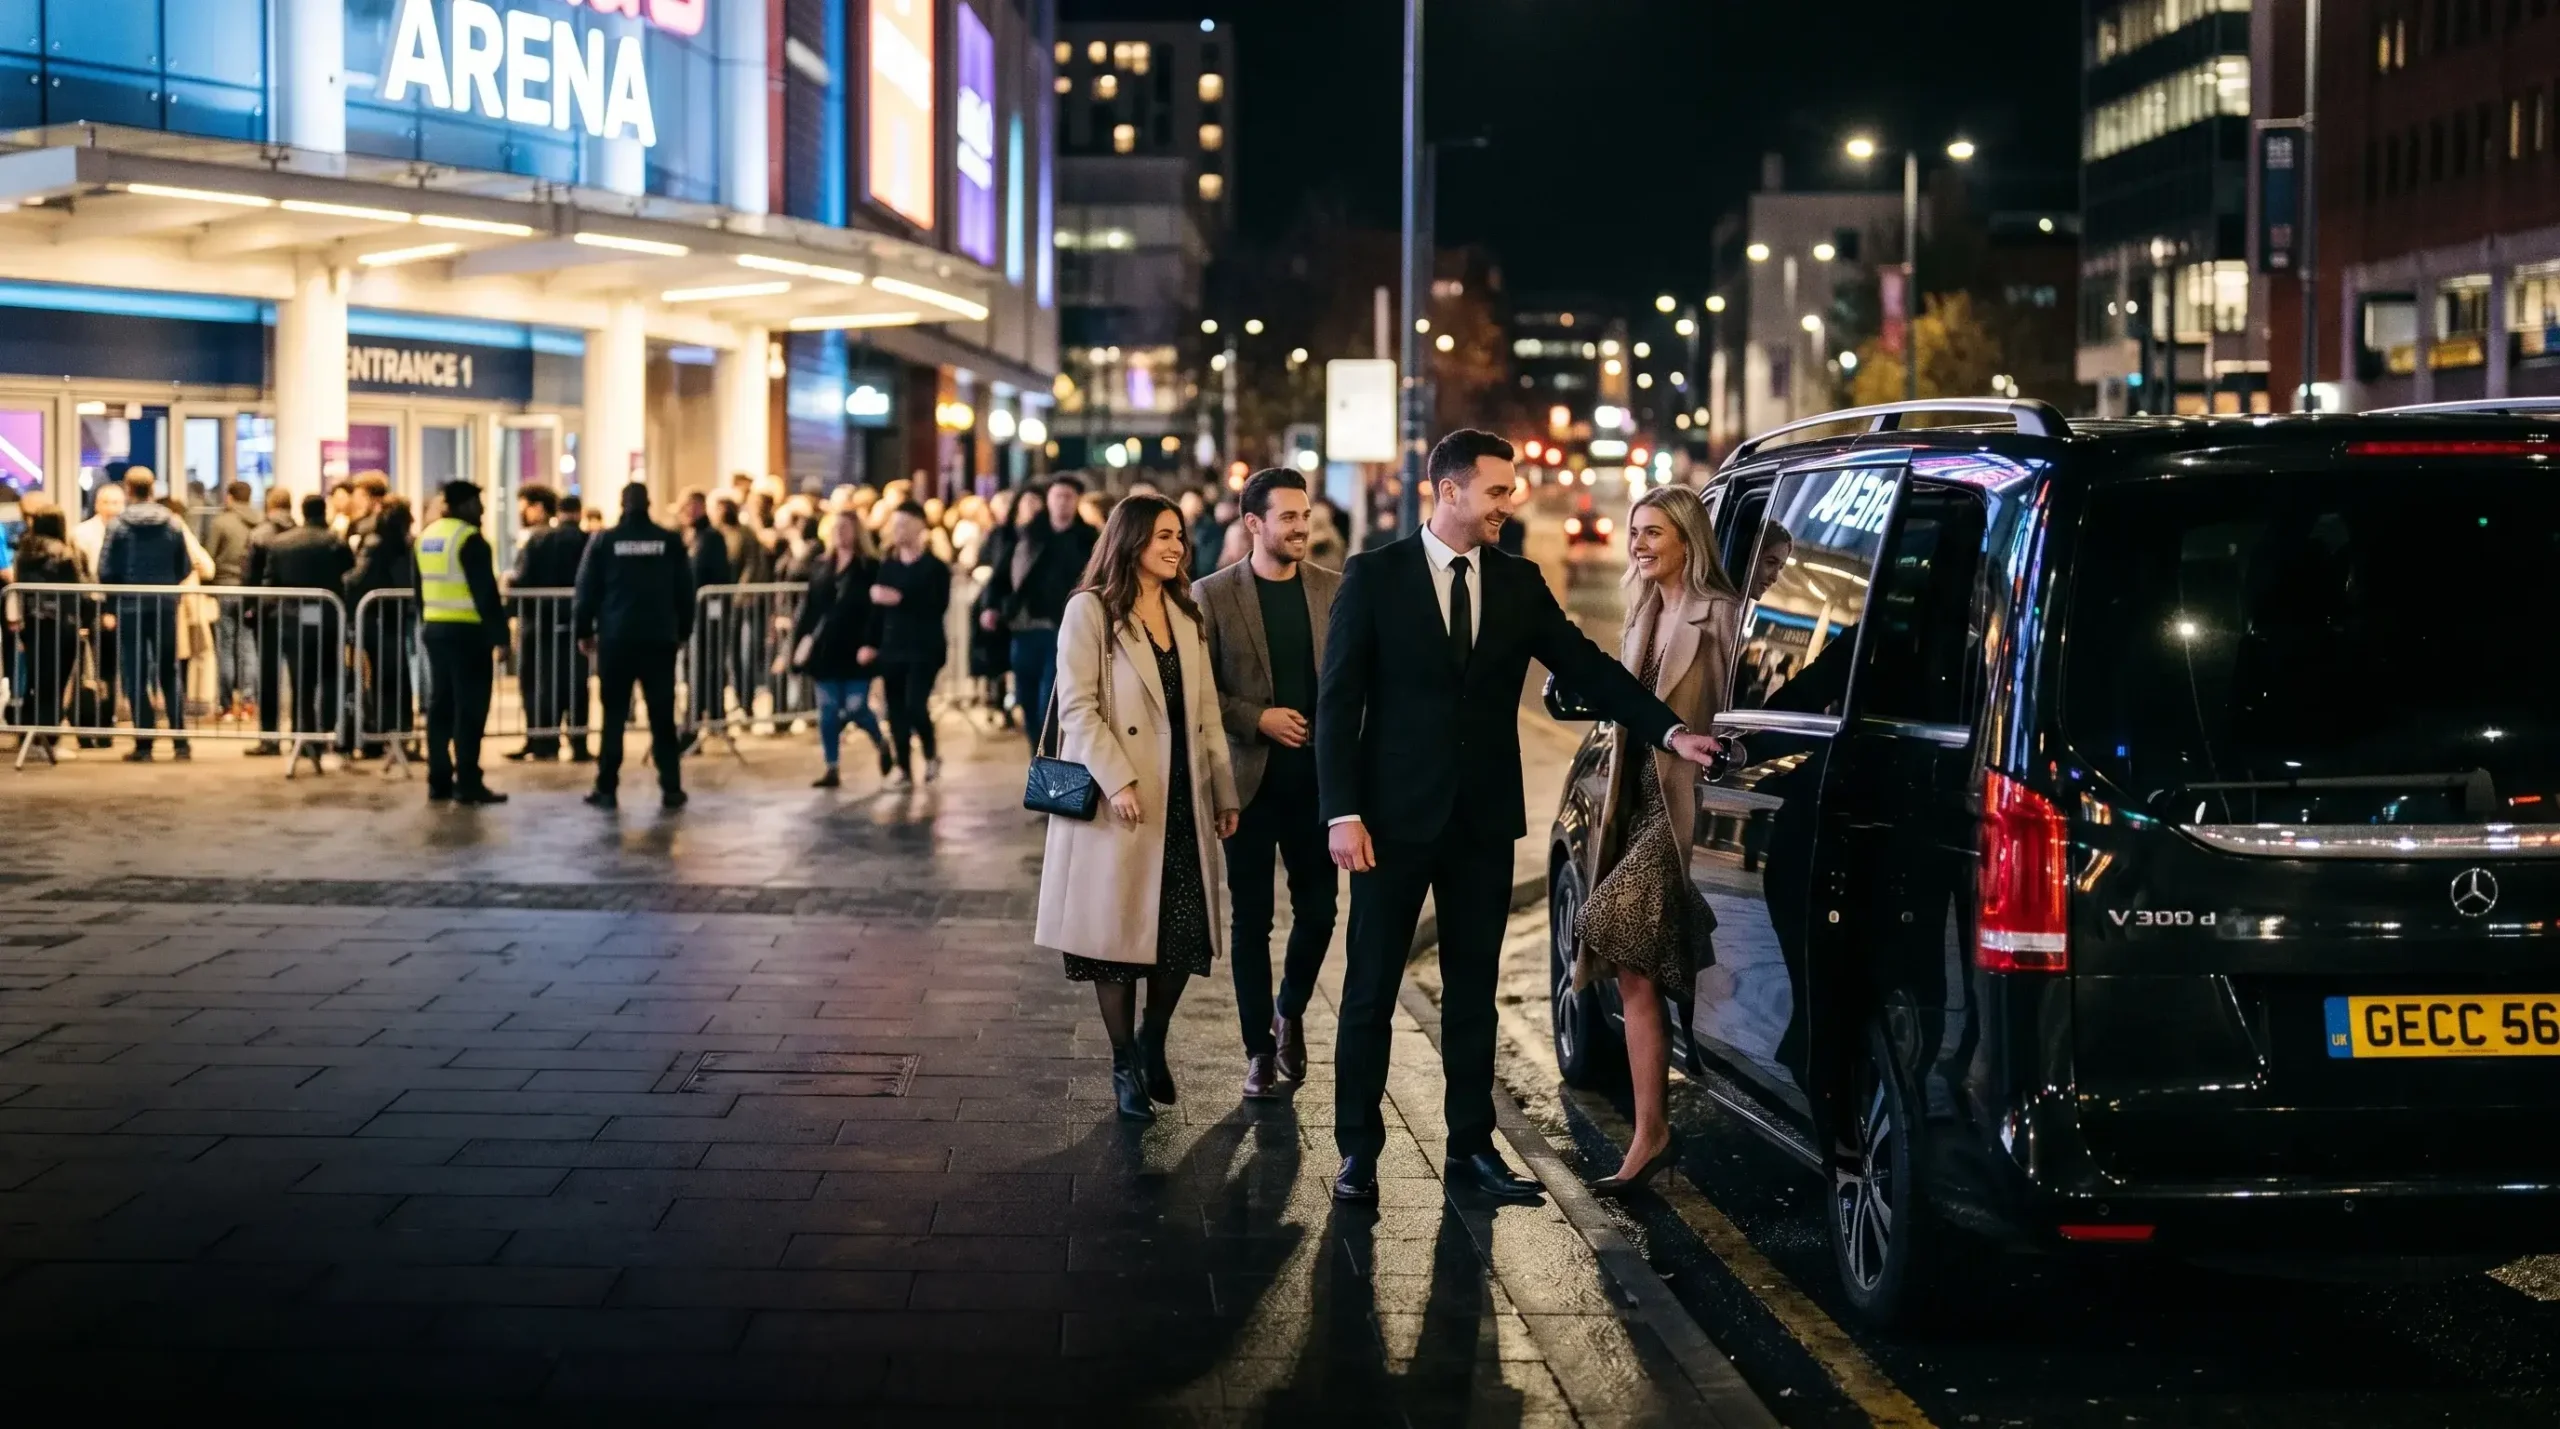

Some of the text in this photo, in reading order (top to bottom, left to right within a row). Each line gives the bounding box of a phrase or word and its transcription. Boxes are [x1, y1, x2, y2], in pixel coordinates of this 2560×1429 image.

[384, 0, 657, 147] ARENA
[460, 354, 473, 388] 1
[2108, 909, 2216, 926] V 300 d
[2332, 1034, 2347, 1046] UK
[2365, 1002, 2559, 1047] GECC 56
